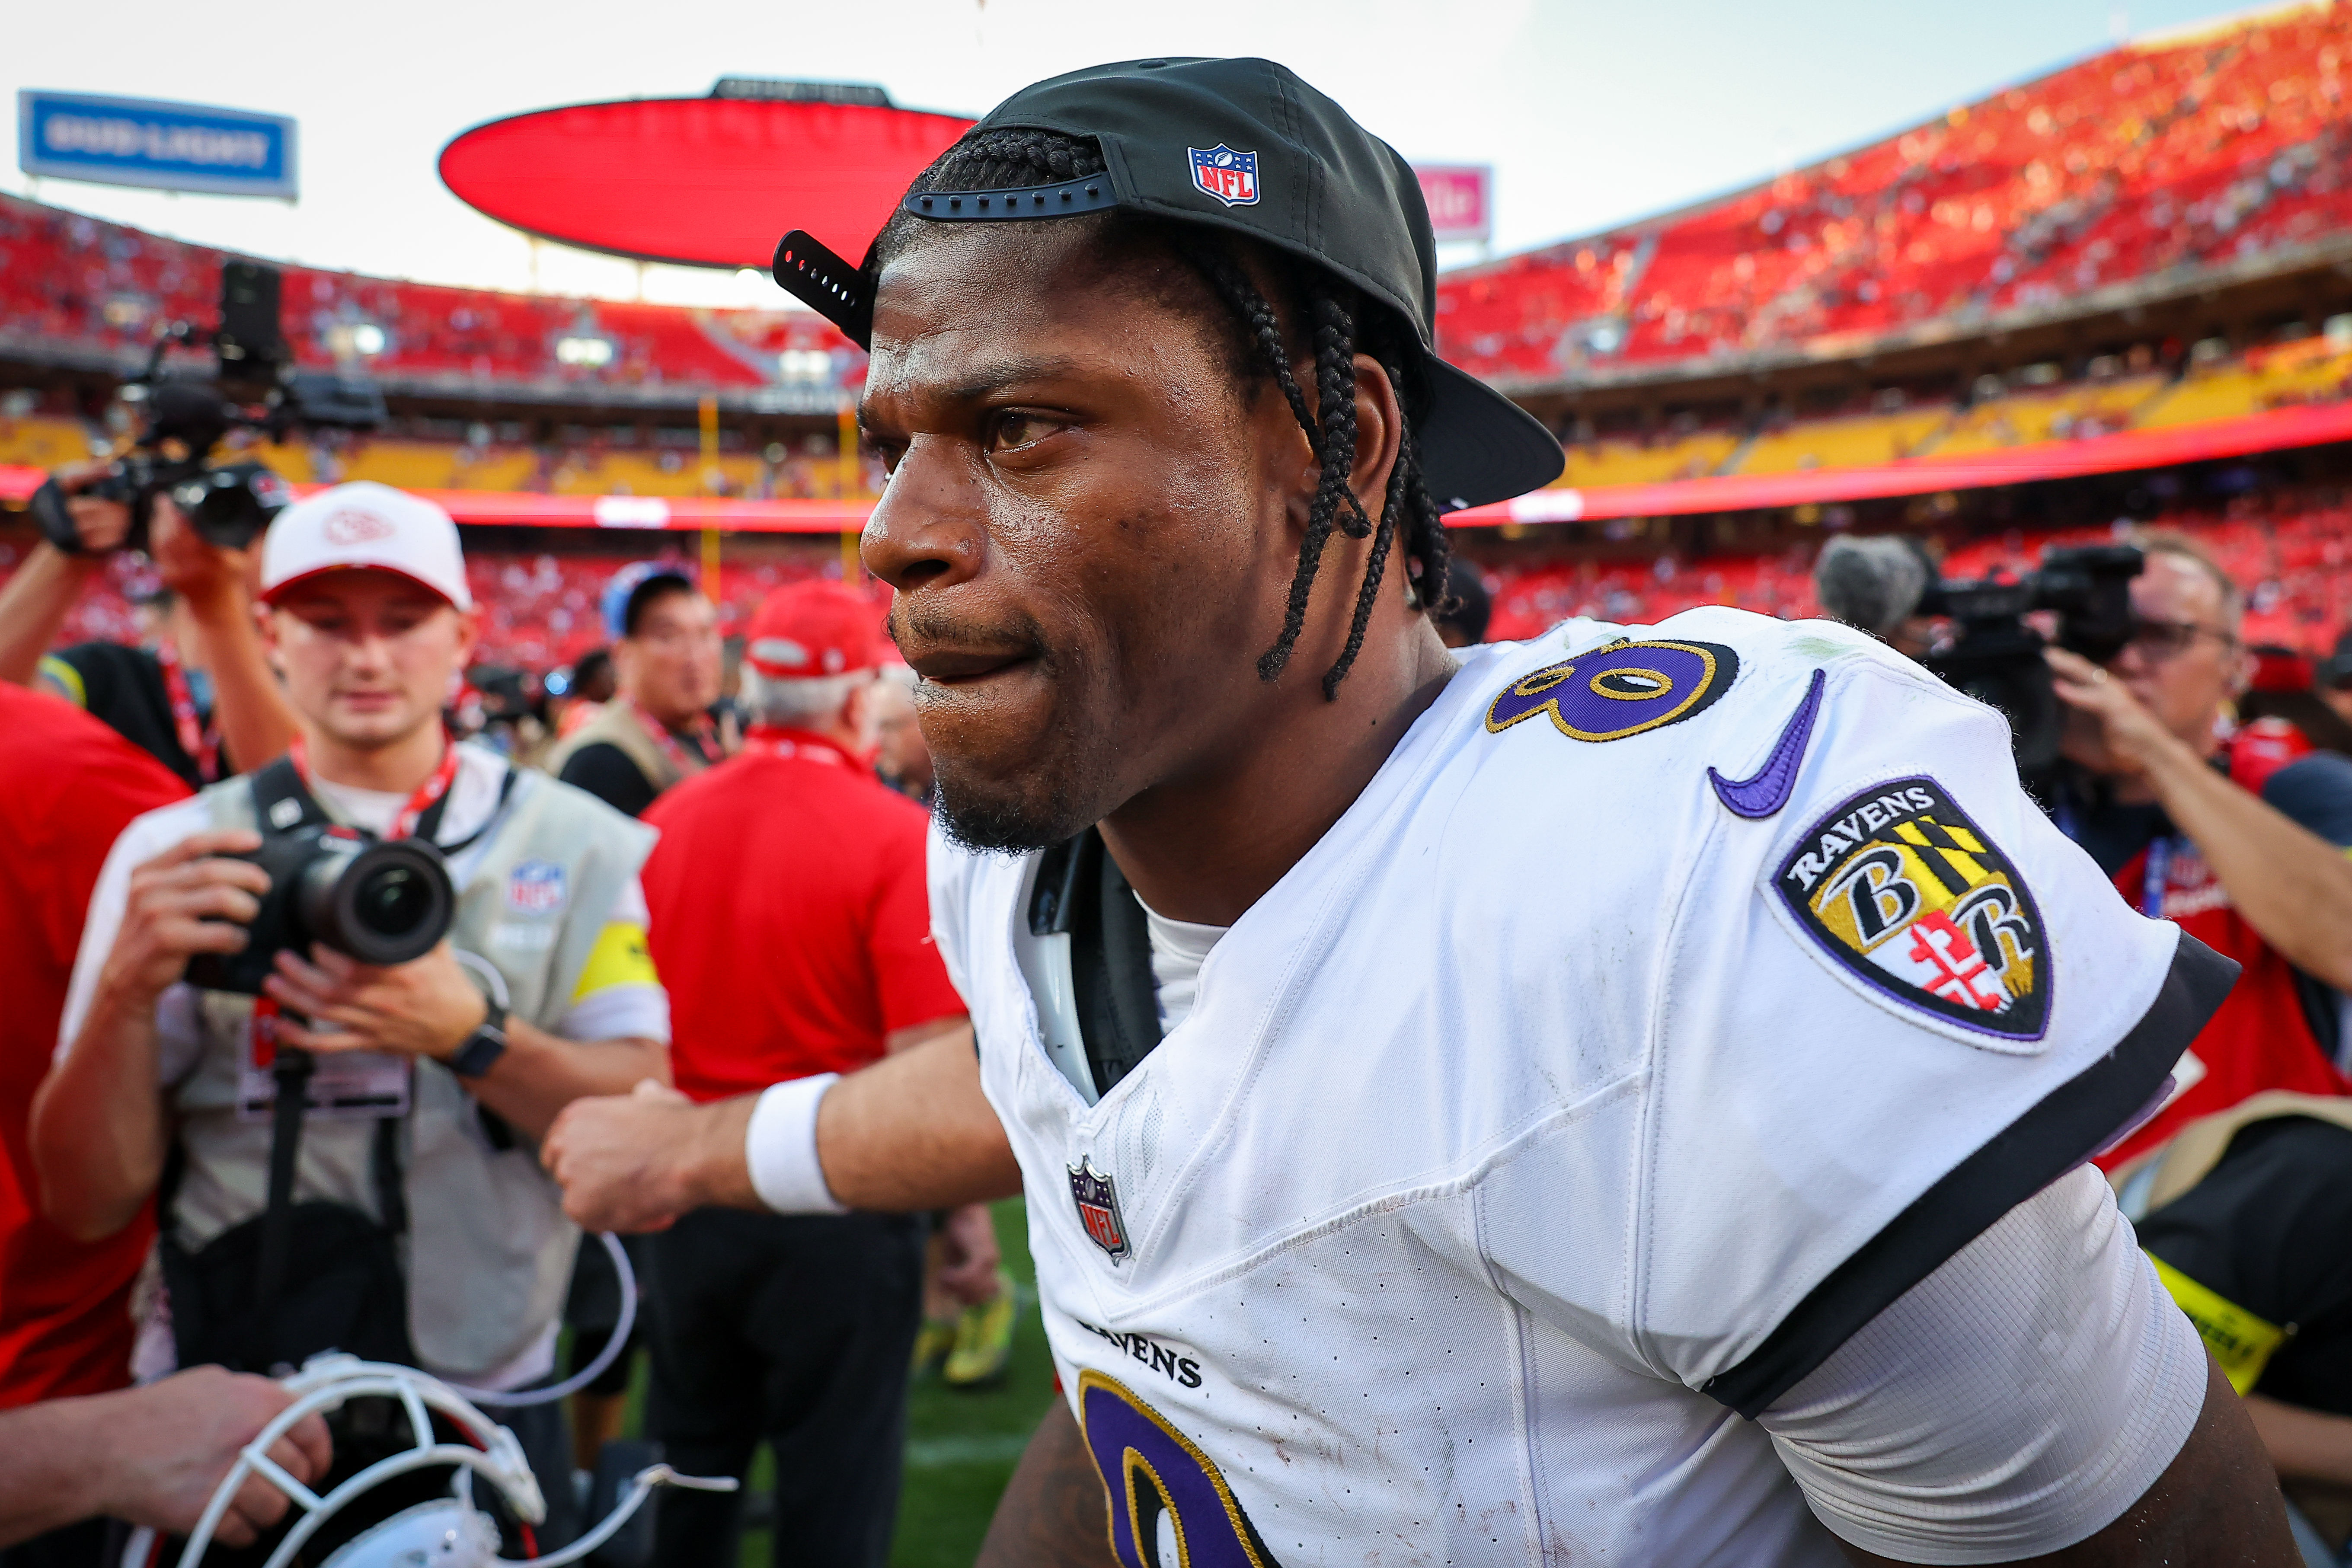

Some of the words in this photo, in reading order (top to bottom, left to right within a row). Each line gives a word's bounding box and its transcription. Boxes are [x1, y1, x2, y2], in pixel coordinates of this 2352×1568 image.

[1200, 165, 1253, 198] NFL
[1486, 637, 1740, 743] 8
[1786, 786, 1936, 892] RAVENS
[1080, 1202, 1120, 1246] NFL
